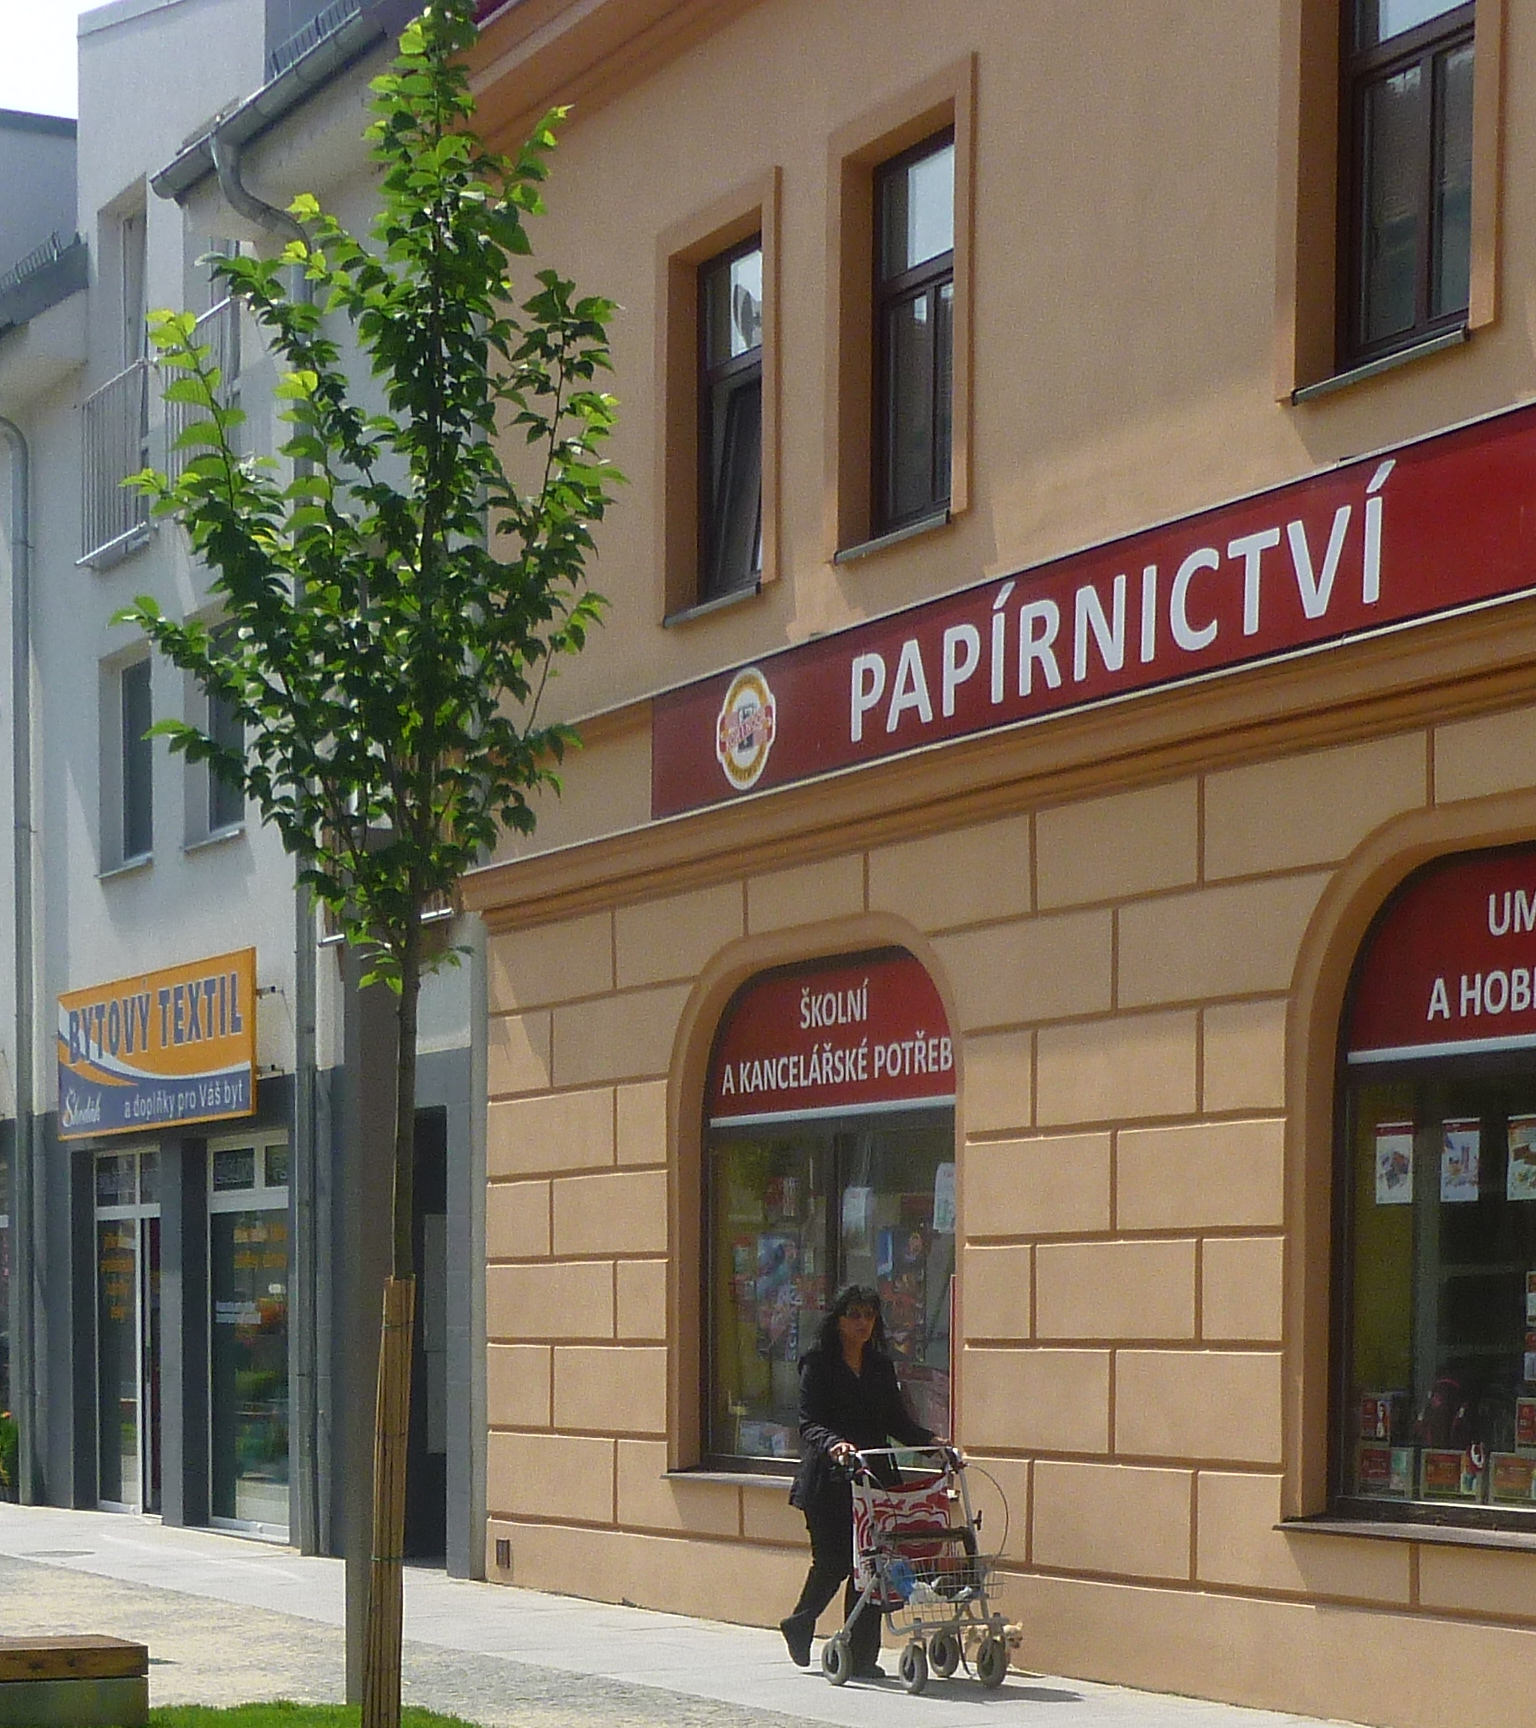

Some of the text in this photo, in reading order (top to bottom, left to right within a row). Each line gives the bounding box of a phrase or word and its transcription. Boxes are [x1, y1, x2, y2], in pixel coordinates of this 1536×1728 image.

[849, 459, 1396, 743] PAPÍRNICTVÍ
[68, 970, 243, 1067] BYTOVÝ TEXTIL
[799, 977, 870, 1030] ŠKOLNÍ
[1426, 977, 1450, 1021] A
[722, 1064, 736, 1096] A
[739, 1037, 869, 1094] KANCELÁŘSKÉ
[124, 1079, 243, 1120] a doplňky pro Váš byt
